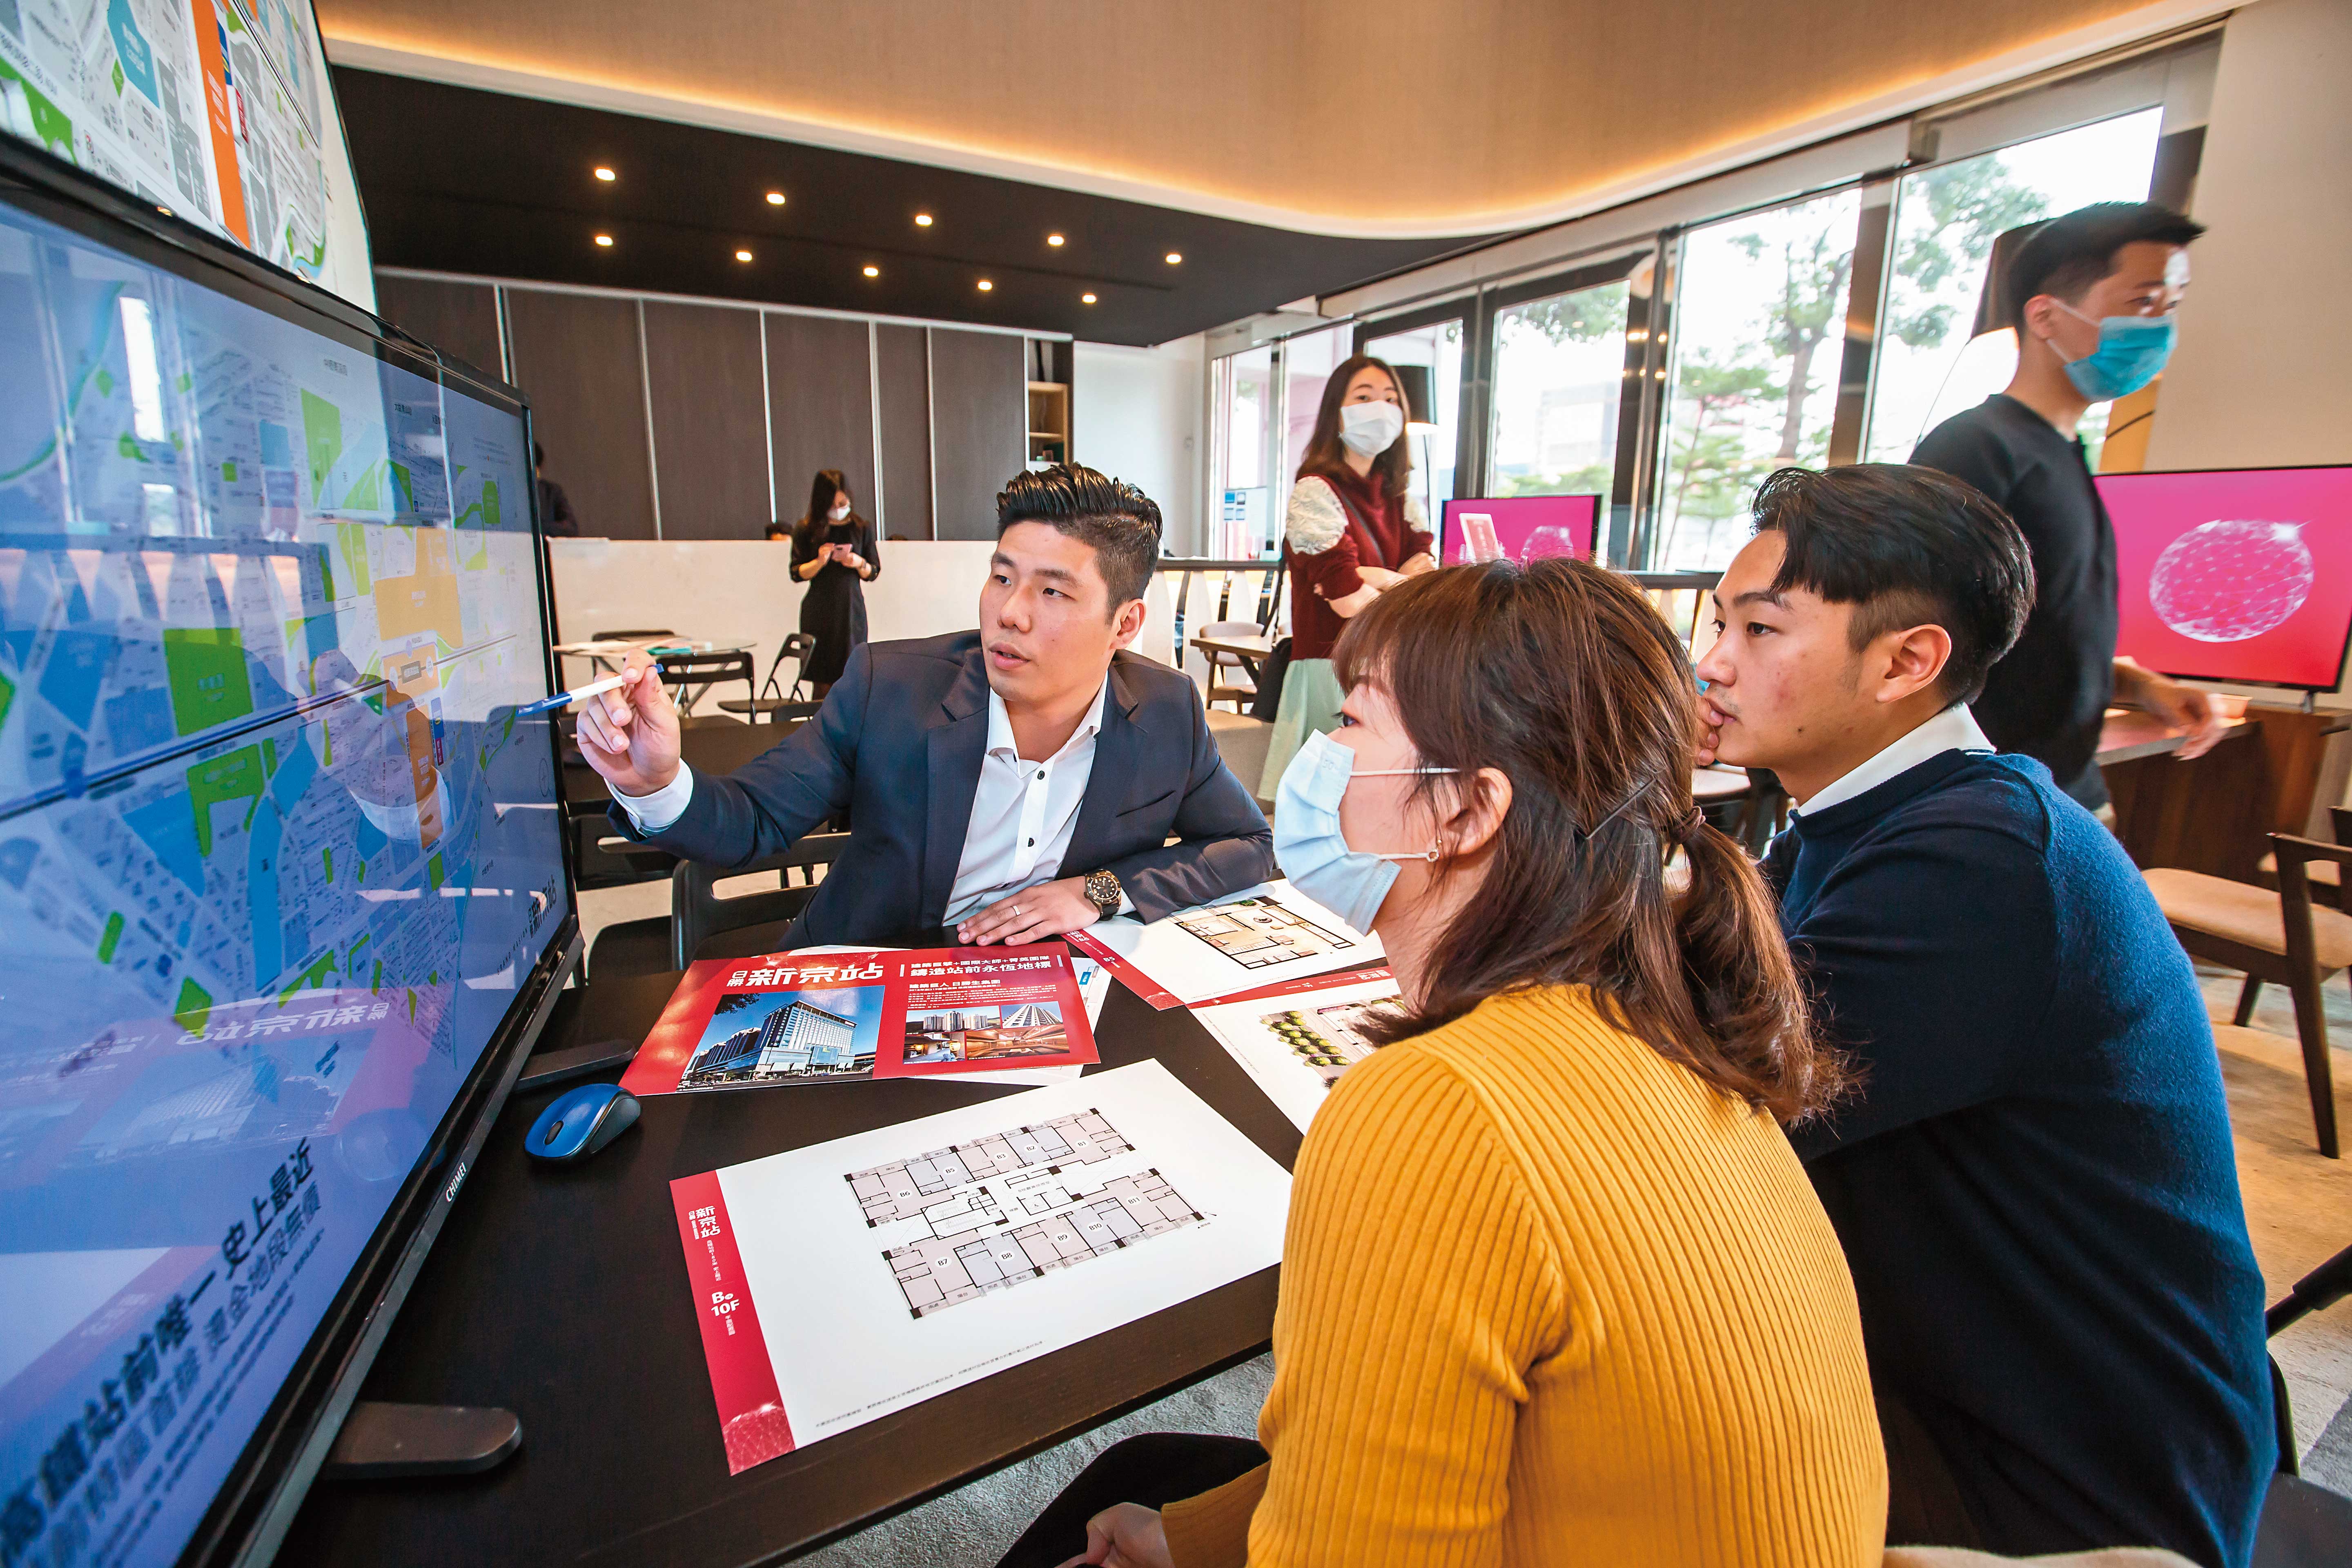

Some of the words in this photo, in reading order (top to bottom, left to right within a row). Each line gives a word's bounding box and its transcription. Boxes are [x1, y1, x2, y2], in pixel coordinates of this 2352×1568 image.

[726, 971, 747, 987] 日勝
[745, 962, 884, 987] 新京站
[910, 961, 1052, 977] 鑄造站前永恆地標
[445, 1162, 467, 1202] CHIMEI
[222, 1136, 314, 1281] 史上最近
[695, 1205, 721, 1238] 新京站
[711, 1299, 739, 1316] 10F
